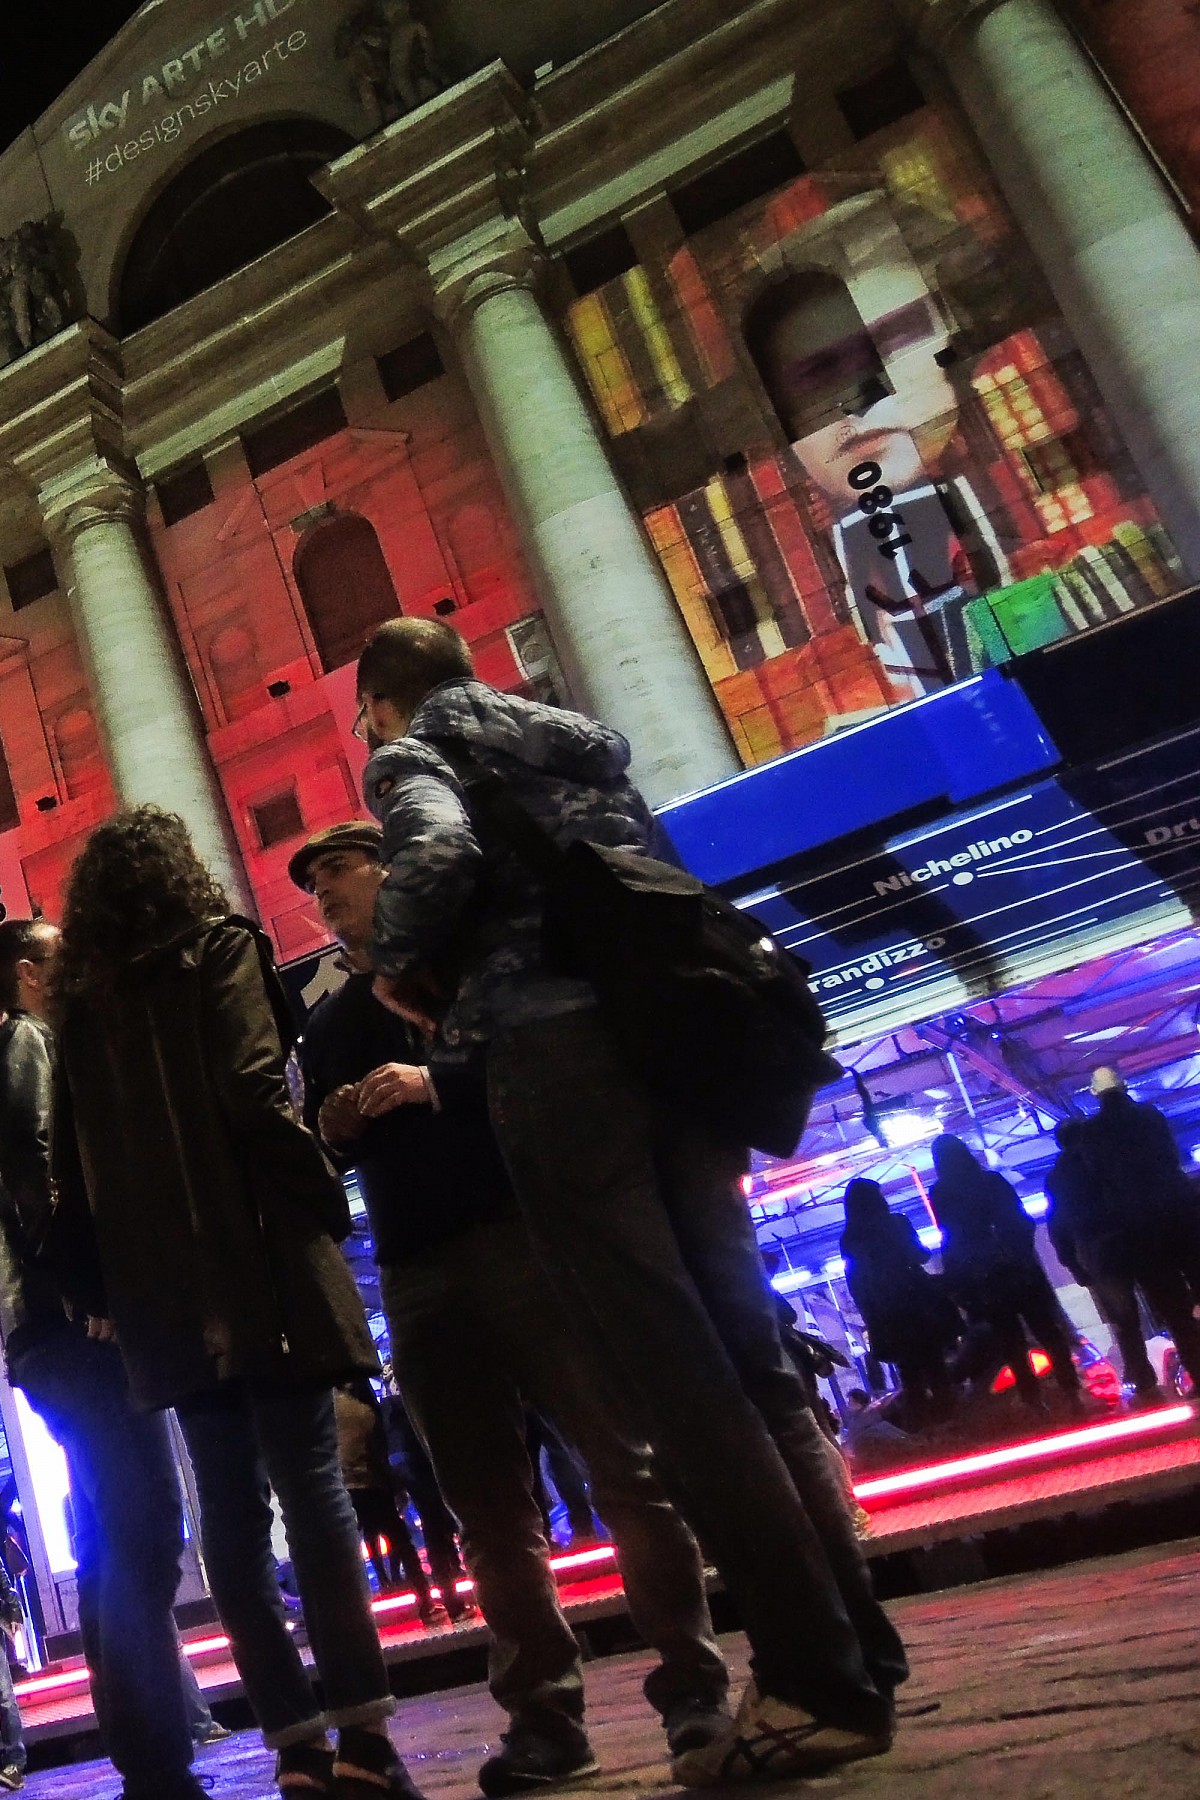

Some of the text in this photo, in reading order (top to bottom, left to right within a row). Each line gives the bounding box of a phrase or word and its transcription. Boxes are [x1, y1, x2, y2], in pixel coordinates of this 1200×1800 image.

[84, 30, 307, 186] #designskyarte
[142, 27, 230, 106] ARTE
[847, 461, 913, 560] 1980
[872, 829, 1033, 896] Nichelino
